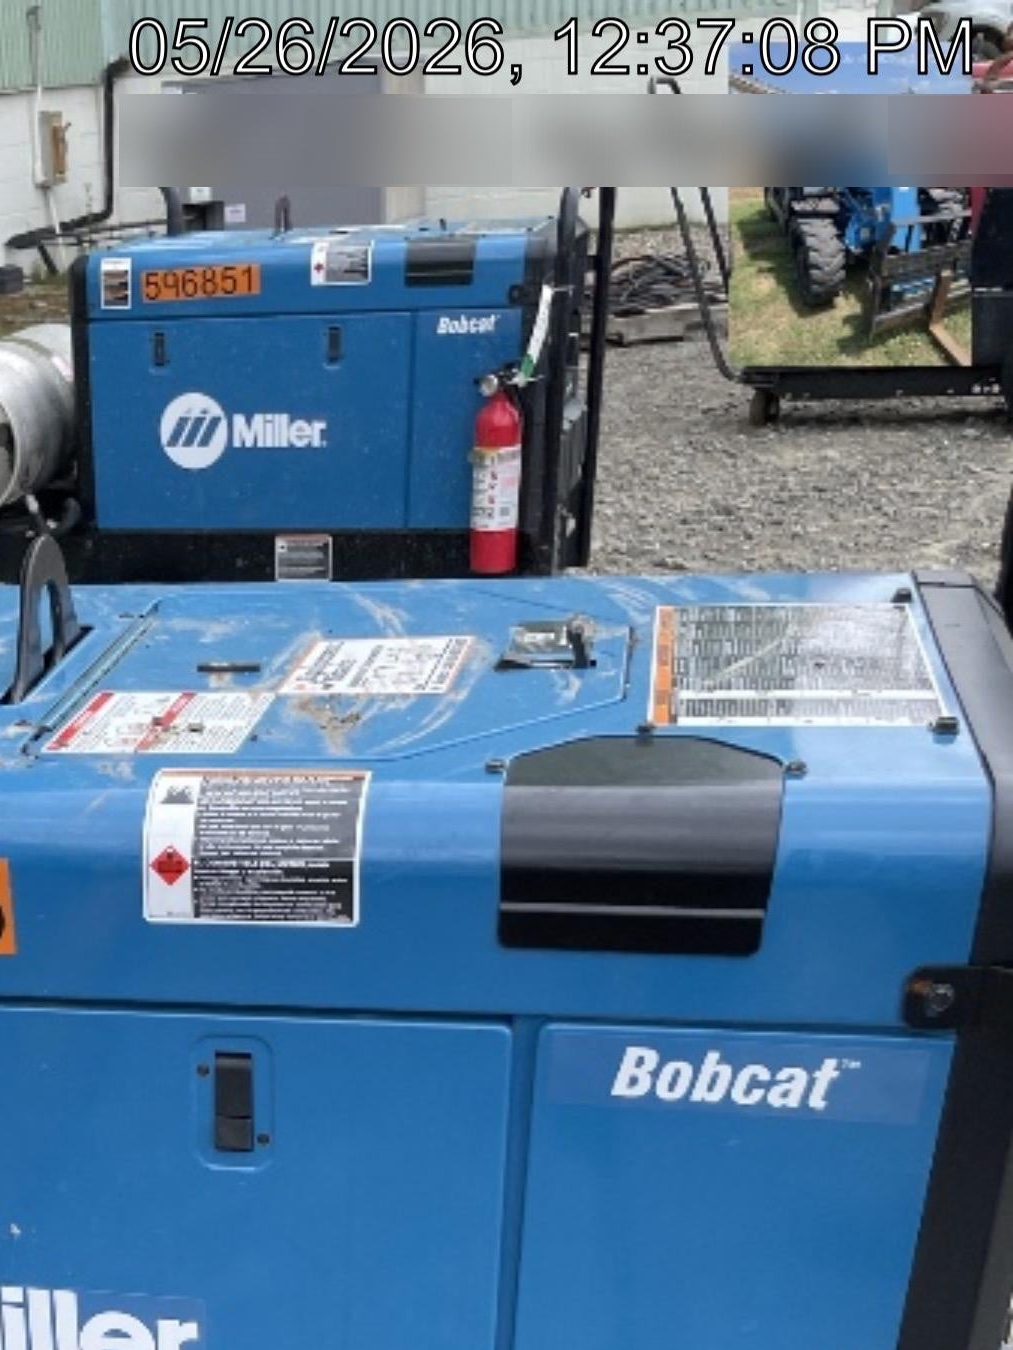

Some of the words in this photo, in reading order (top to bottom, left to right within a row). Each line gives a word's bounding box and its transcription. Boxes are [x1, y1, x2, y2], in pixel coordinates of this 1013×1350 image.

[144, 266, 254, 300] 596851
[437, 315, 496, 334] Bobcat
[233, 413, 325, 448] Miller
[610, 1046, 840, 1110] Bobcat
